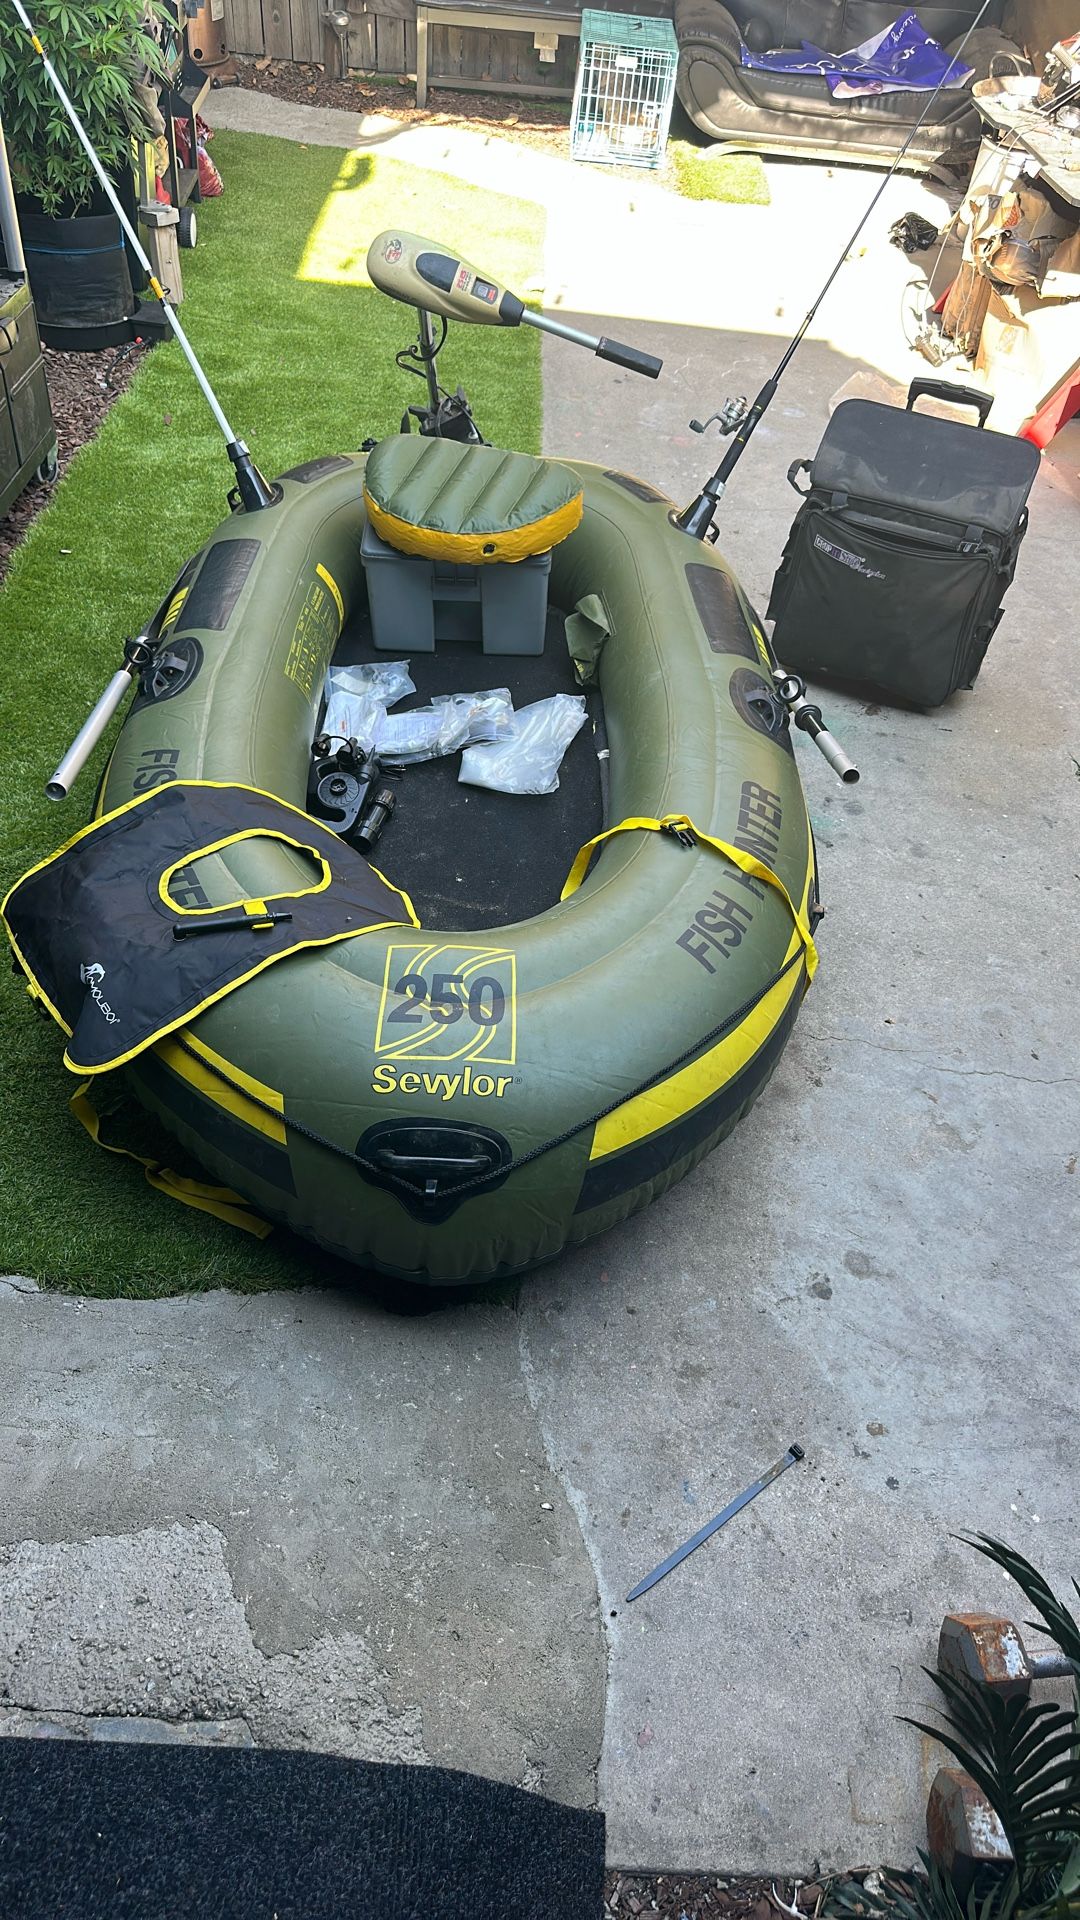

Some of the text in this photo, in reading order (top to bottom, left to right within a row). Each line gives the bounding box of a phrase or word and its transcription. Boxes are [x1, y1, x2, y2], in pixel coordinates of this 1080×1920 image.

[132, 749, 181, 797] FIS
[675, 890, 754, 975] FISH
[387, 973, 506, 1027] 250
[371, 1063, 514, 1102] Sevylor
